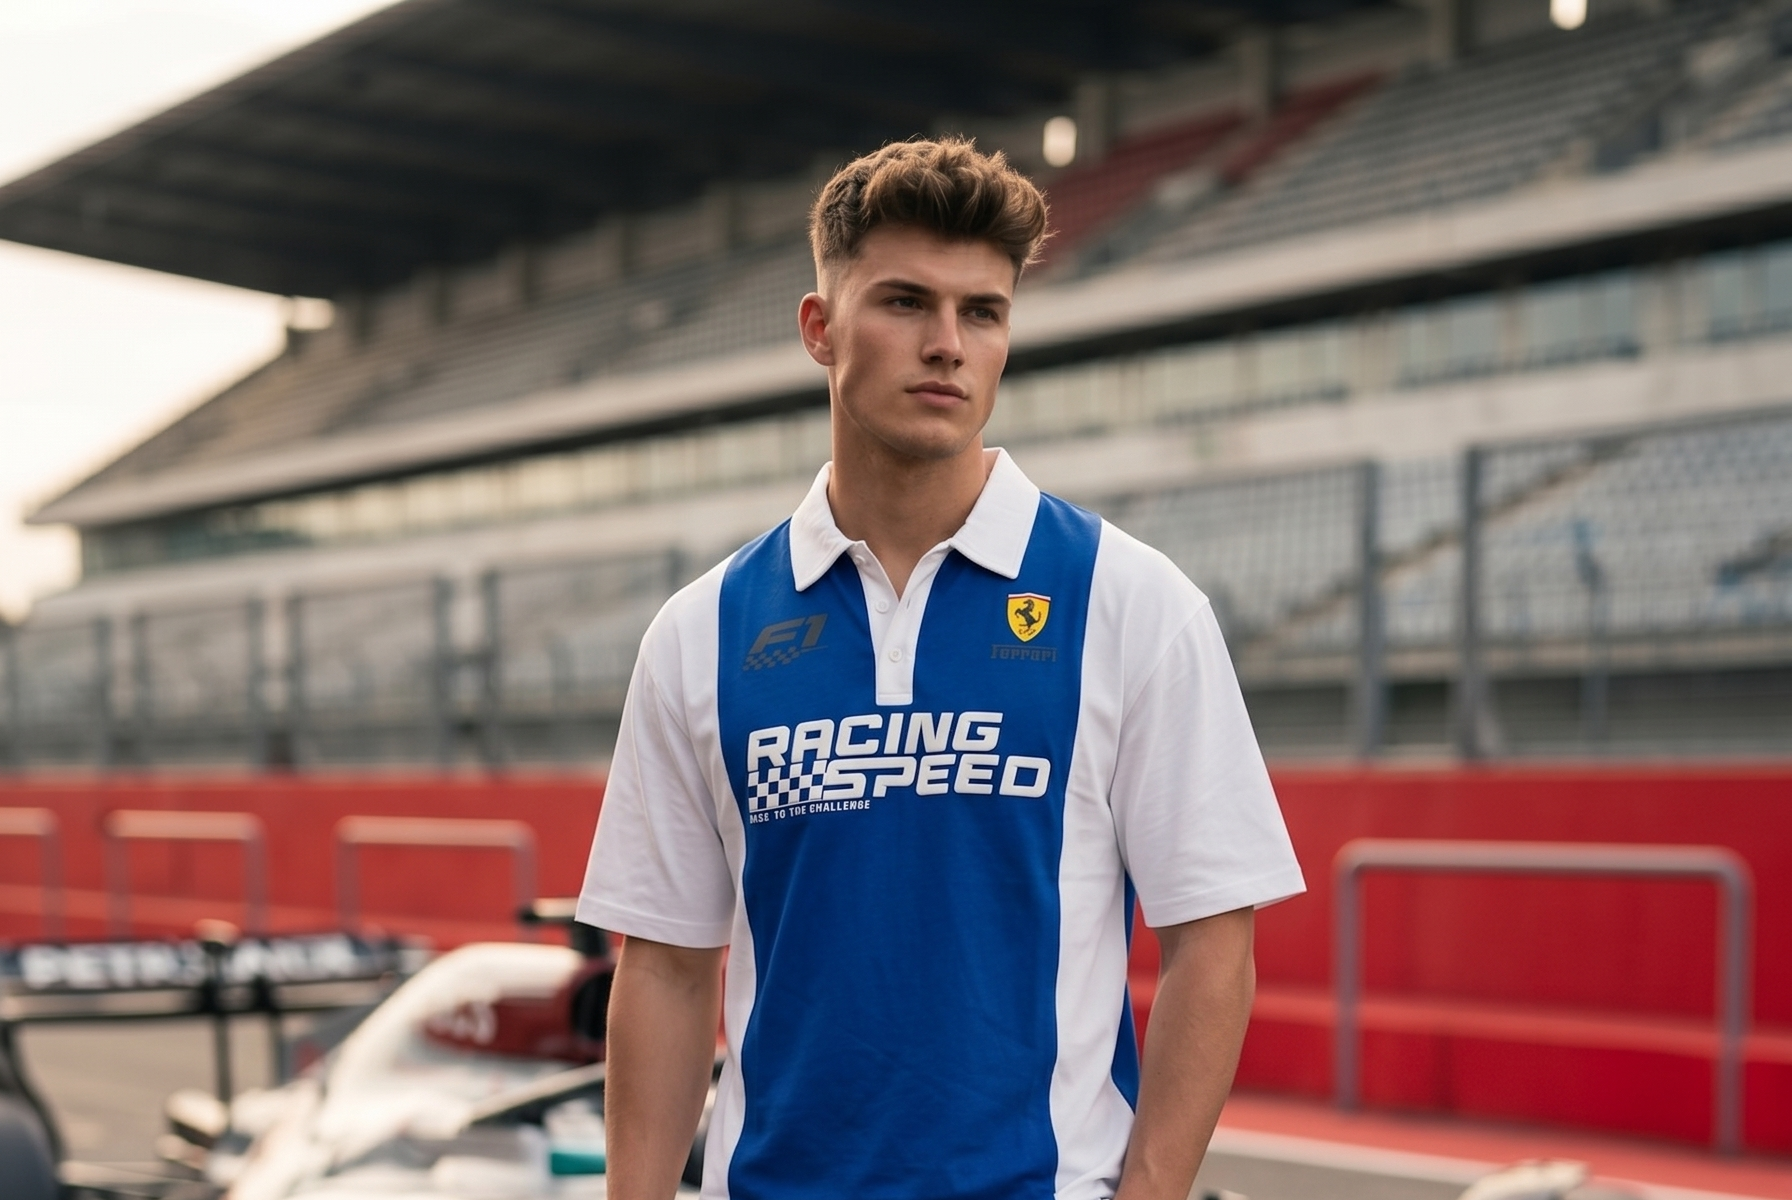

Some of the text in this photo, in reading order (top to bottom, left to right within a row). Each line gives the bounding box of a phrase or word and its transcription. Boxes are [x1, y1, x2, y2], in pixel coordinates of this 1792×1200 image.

[748, 613, 828, 655] F1
[748, 712, 1003, 772] RACING
[822, 754, 1051, 798] SPEED
